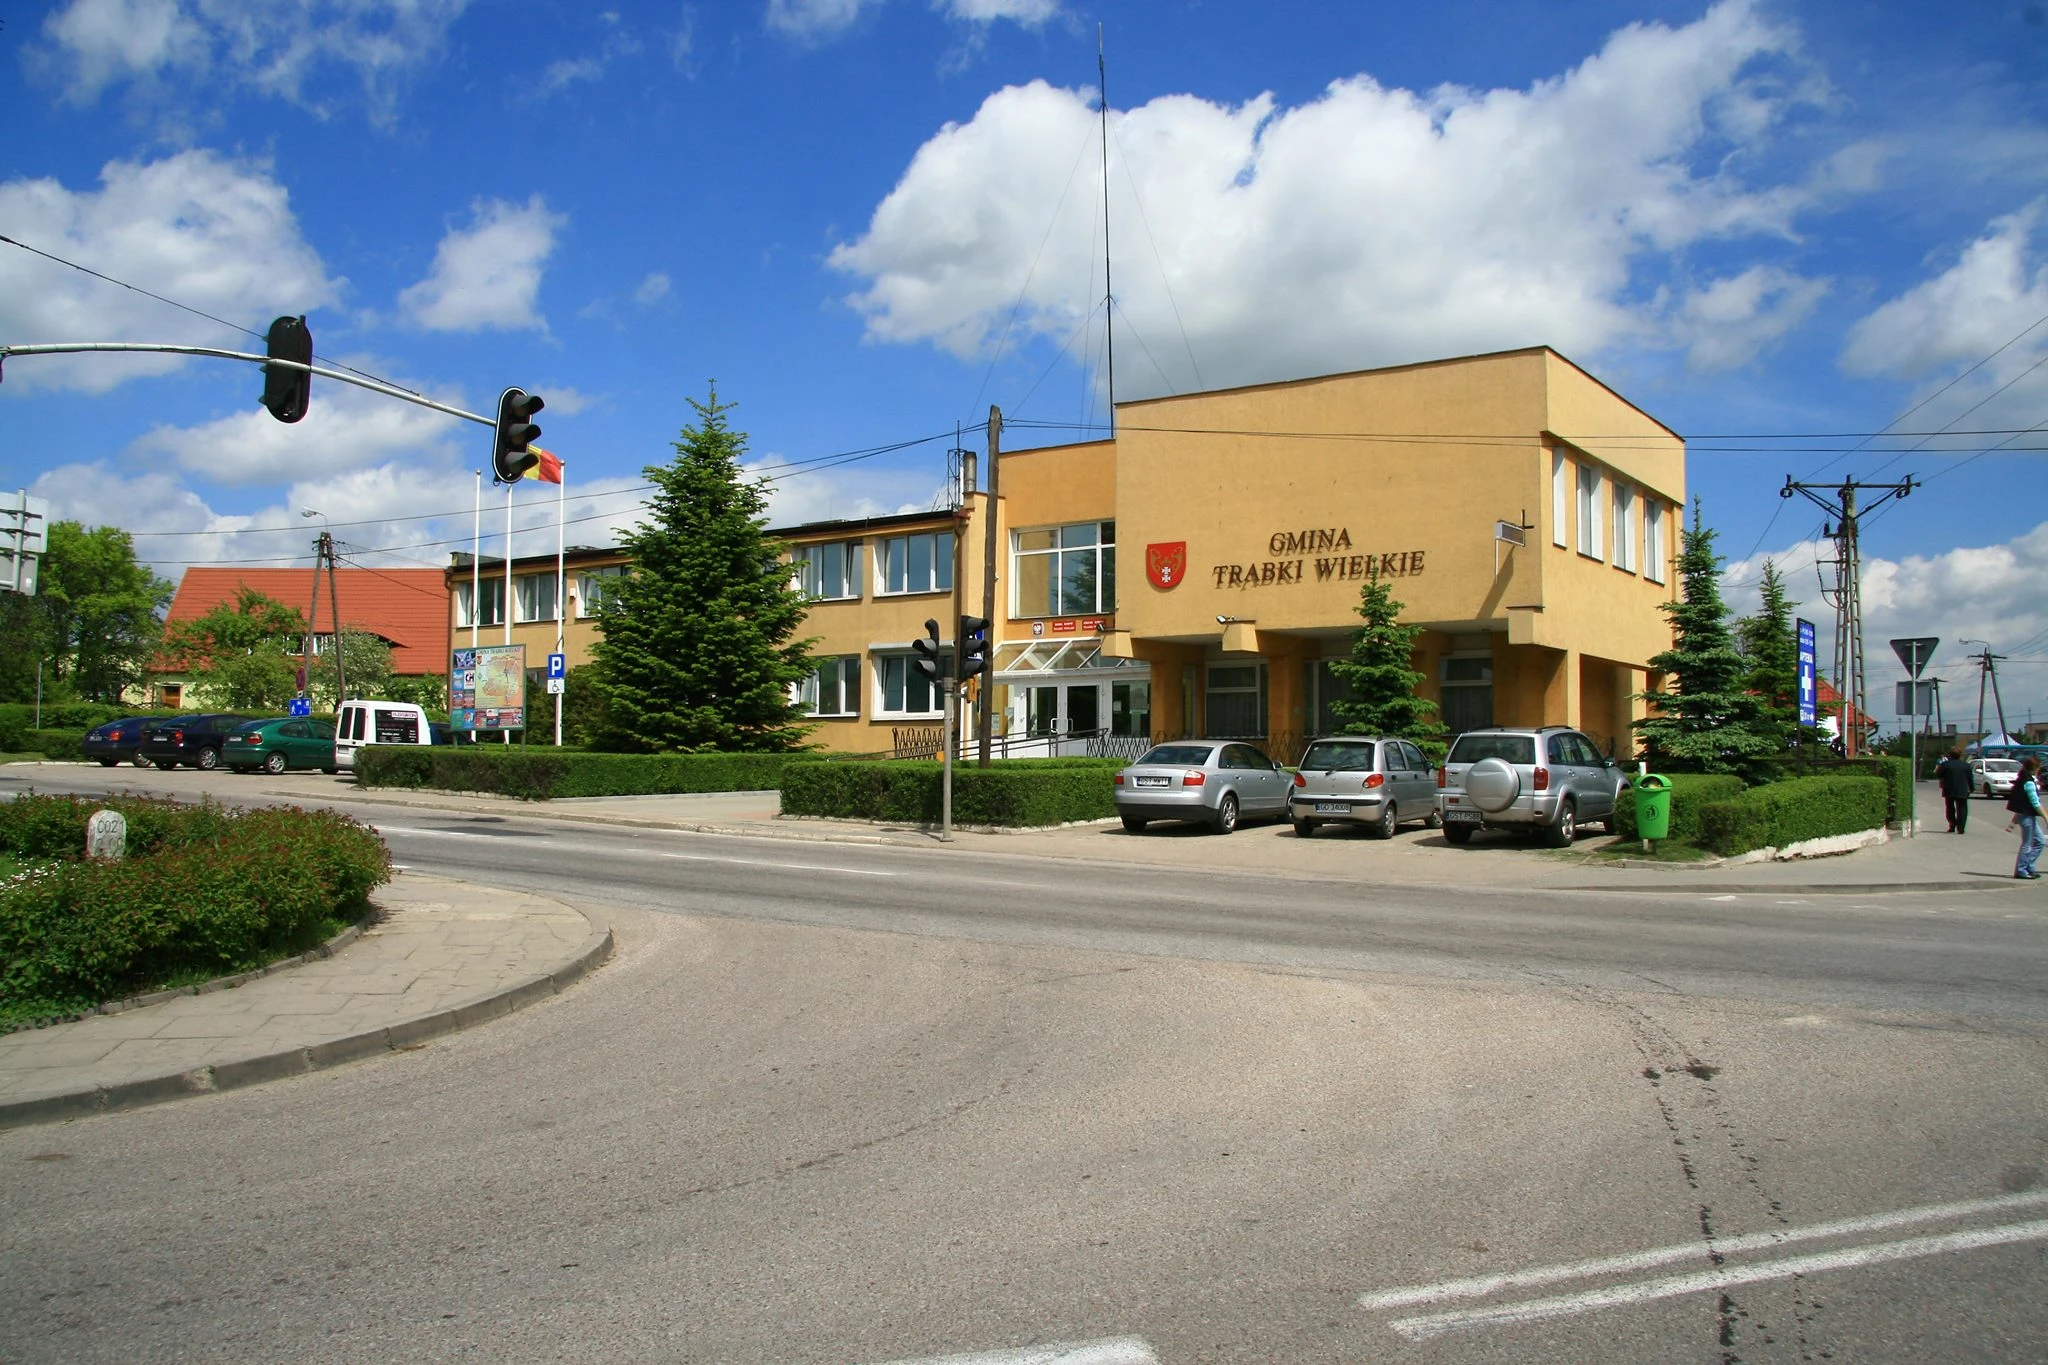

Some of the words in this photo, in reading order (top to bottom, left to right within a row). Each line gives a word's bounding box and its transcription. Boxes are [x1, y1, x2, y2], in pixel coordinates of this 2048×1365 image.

[1270, 528, 1352, 552] GMINA
[1314, 551, 1425, 578] WIELKIE
[551, 656, 562, 676] P
